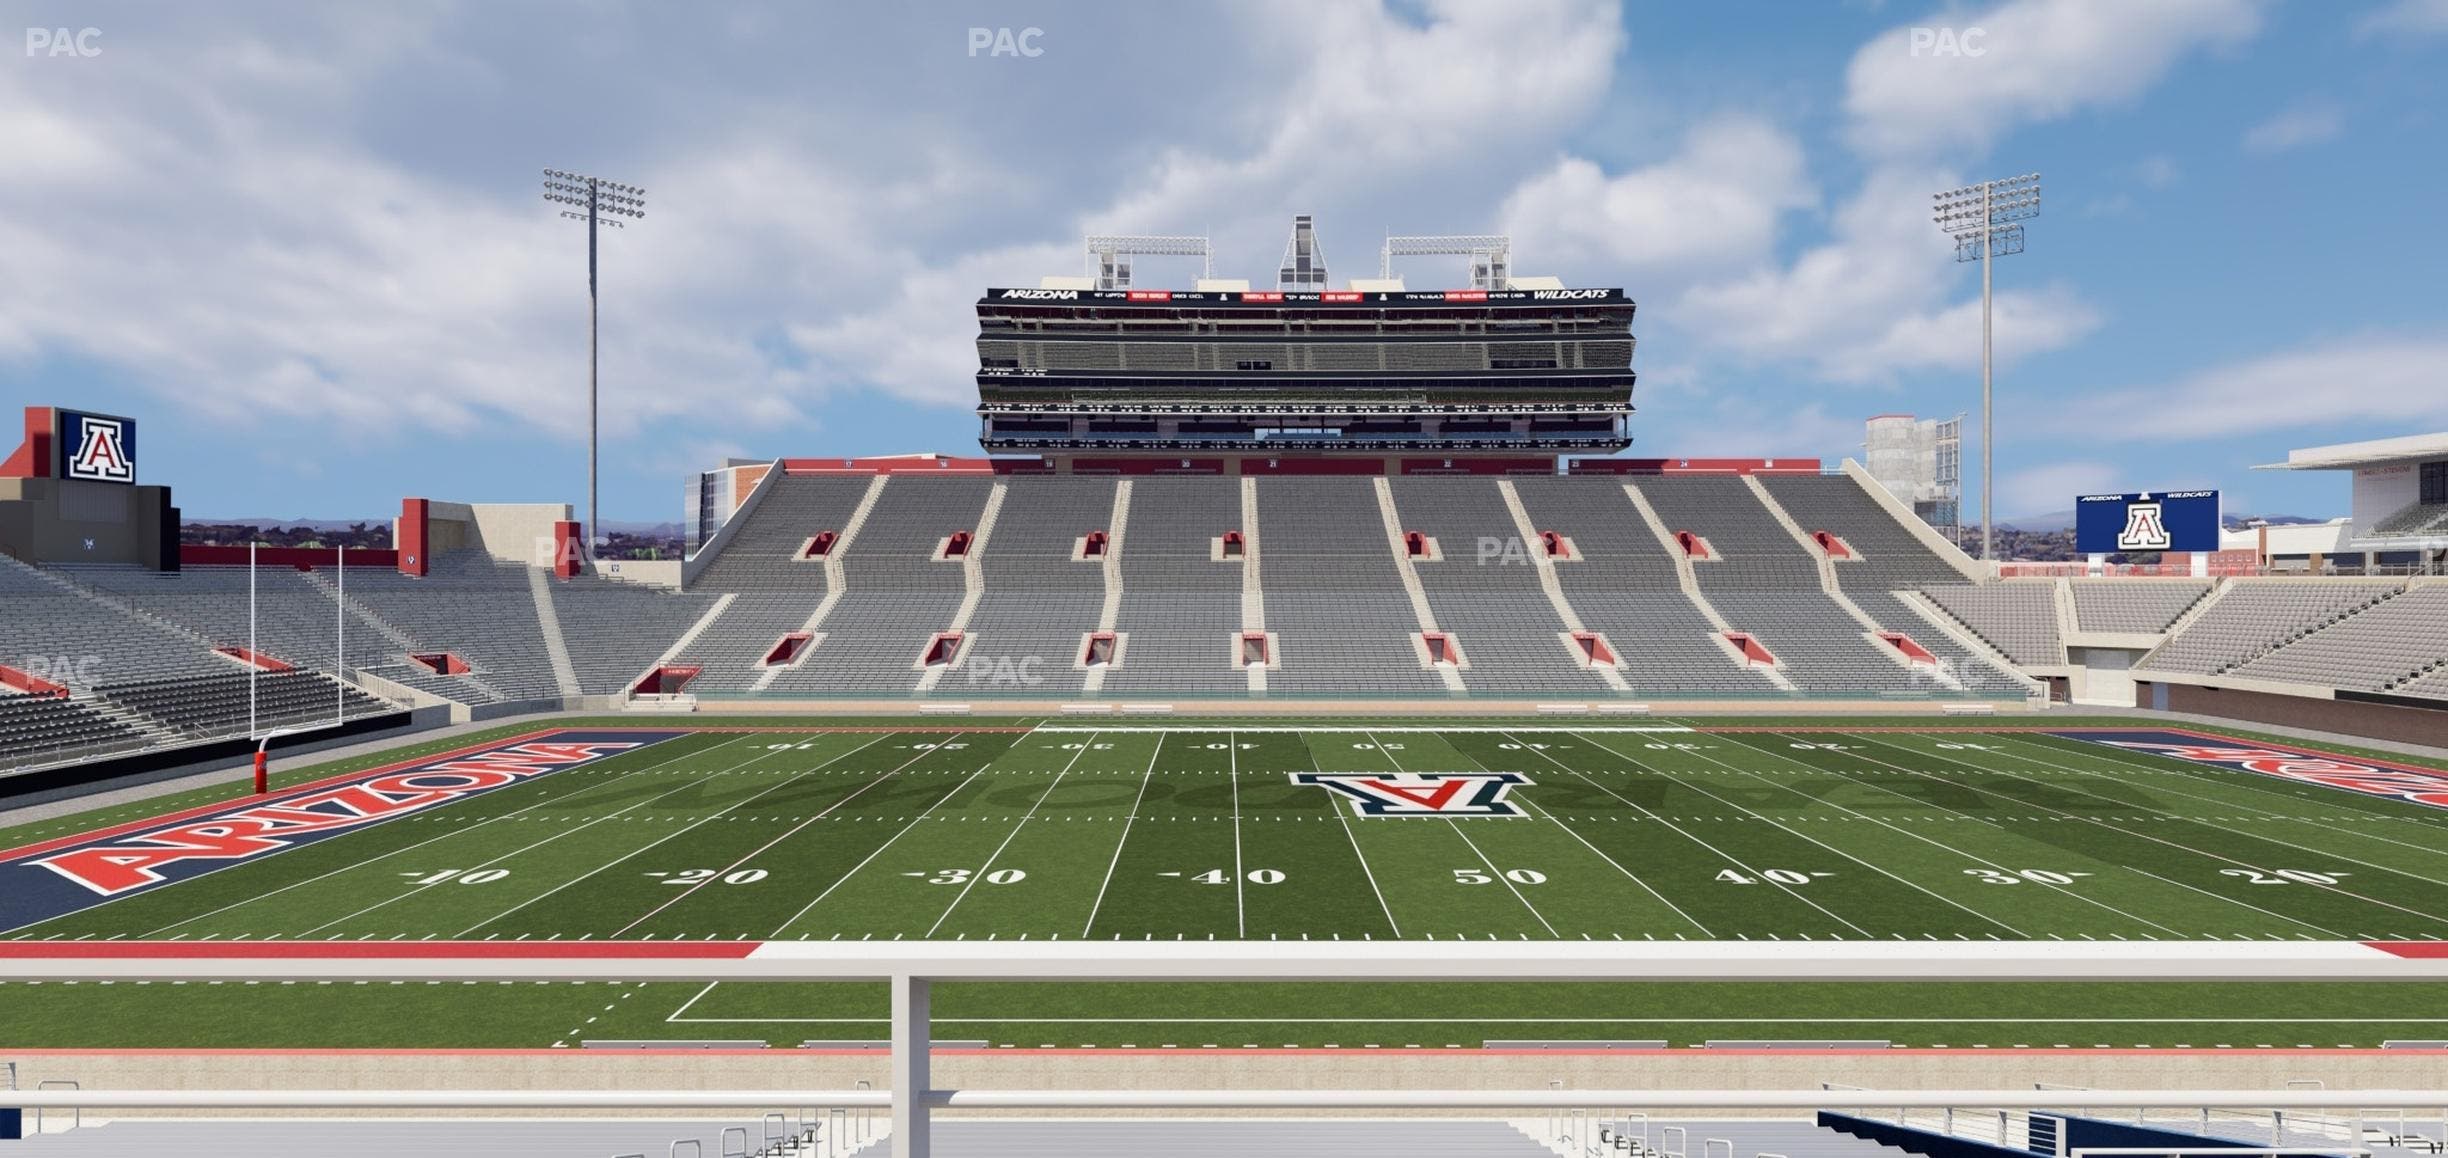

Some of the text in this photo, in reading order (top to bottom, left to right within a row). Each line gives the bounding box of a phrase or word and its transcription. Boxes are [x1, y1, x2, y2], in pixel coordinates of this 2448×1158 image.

[1001, 289, 1078, 300] ARIZONA
[1534, 289, 1609, 299] WILDCATS
[69, 416, 134, 483] A
[2081, 494, 2122, 502] ARIZONA
[2167, 491, 2213, 499] WILDCATS
[2118, 503, 2171, 549] A
[20, 743, 644, 896] ARIZONA
[404, 869, 510, 885] 10
[661, 869, 768, 885] 20
[928, 869, 1026, 885] 30
[1191, 869, 1286, 885] 40
[1453, 869, 1547, 885] 50
[1715, 869, 1811, 885] 40
[1963, 869, 2073, 885] 30
[2219, 869, 2339, 885] 20
